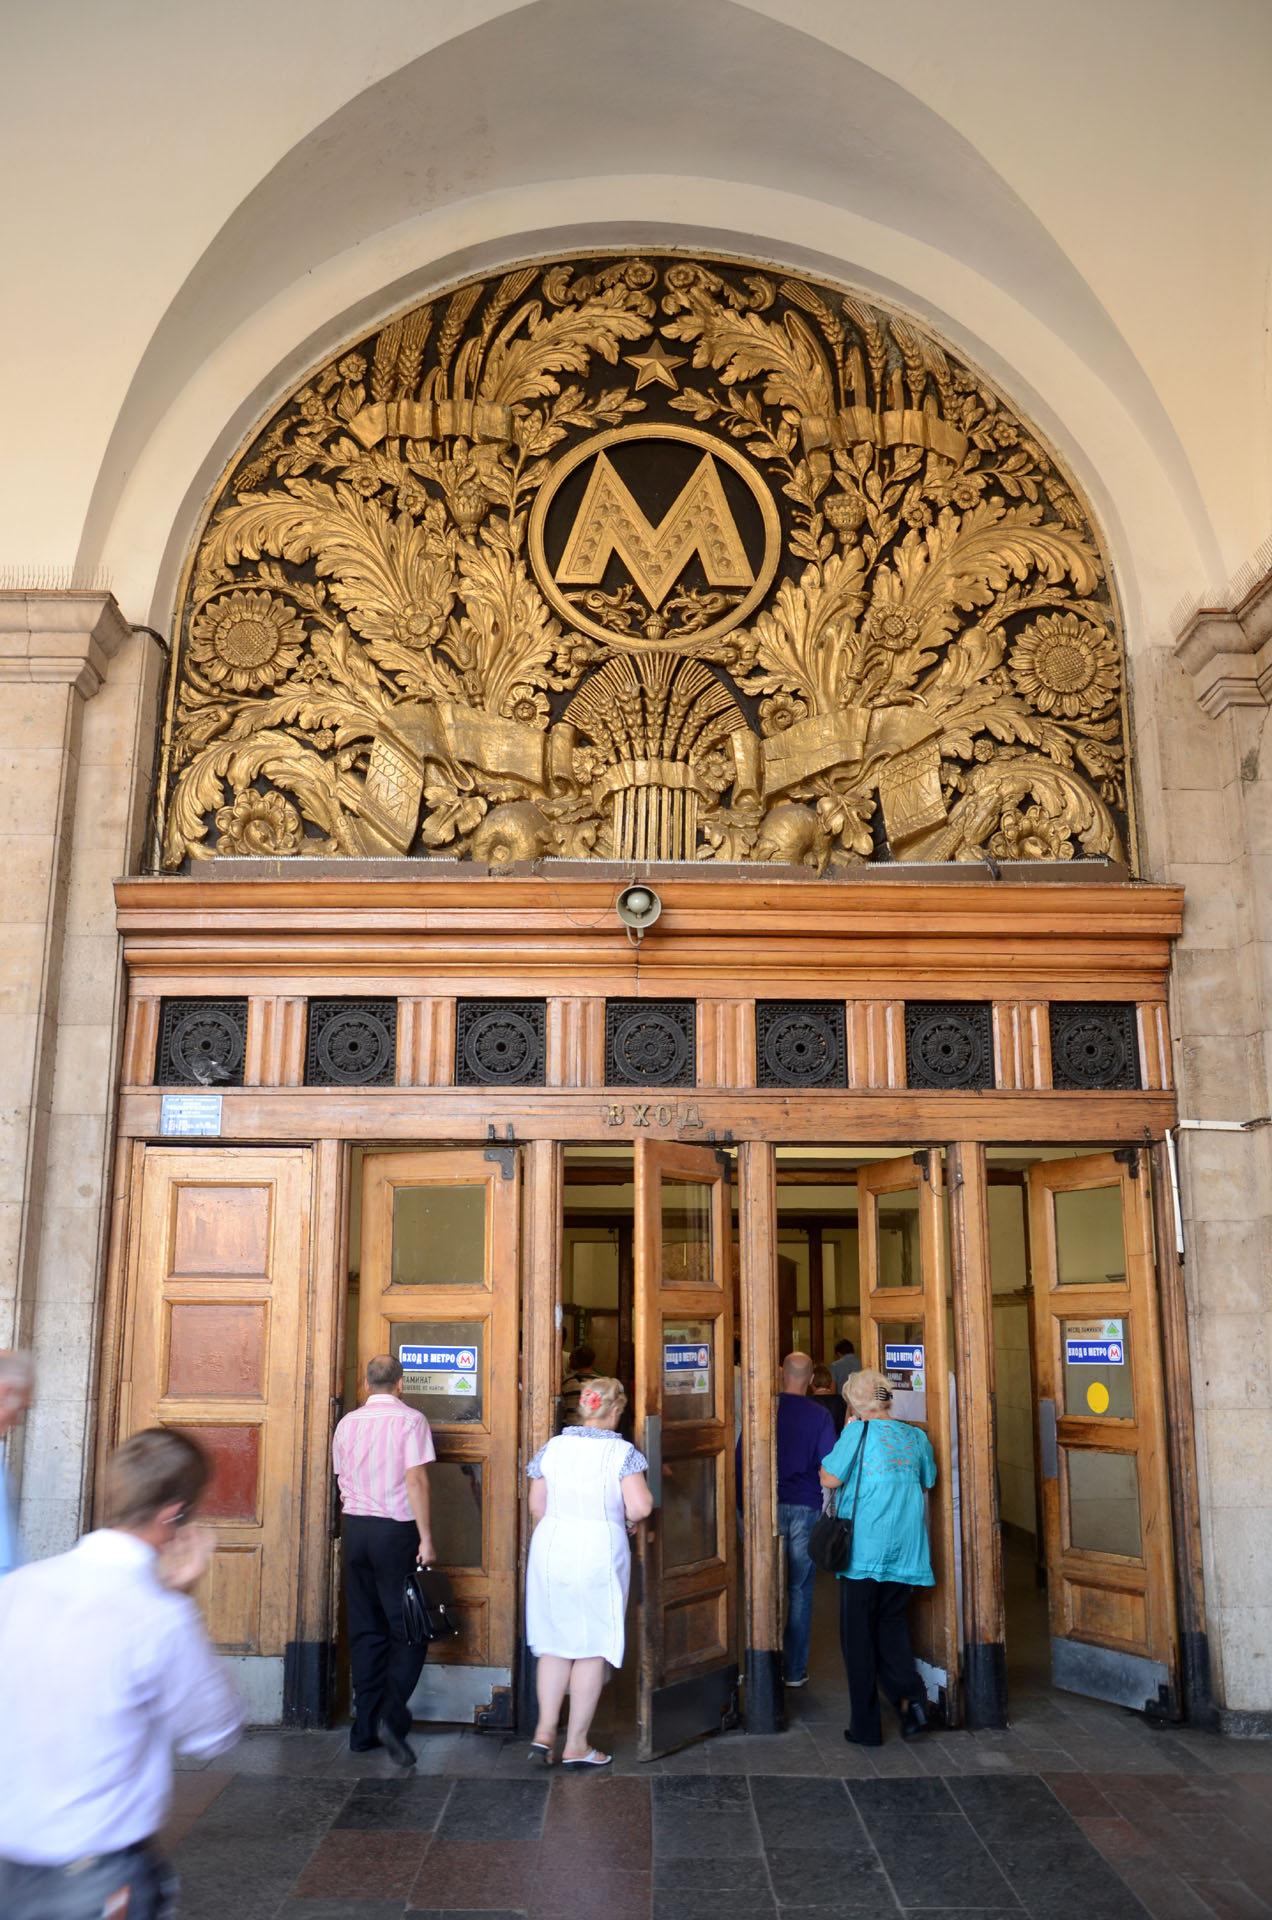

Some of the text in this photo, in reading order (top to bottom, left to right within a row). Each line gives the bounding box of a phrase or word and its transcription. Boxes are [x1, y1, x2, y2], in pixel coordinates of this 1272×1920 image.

[555, 449, 756, 610] М
[607, 1103, 704, 1128] ВХОД
[402, 1353, 422, 1364] ВХОД
[423, 1353, 429, 1362] В
[430, 1353, 455, 1363] МЕТРО
[665, 1352, 679, 1364] ВХОД
[682, 1352, 697, 1362] МЕТРО
[887, 1351, 896, 1363] ВХОД
[900, 1352, 913, 1361] МЕТРО
[1068, 1347, 1083, 1358] ВХОД
[1083, 1347, 1088, 1356] В
[1088, 1347, 1107, 1357] МЕТРО
